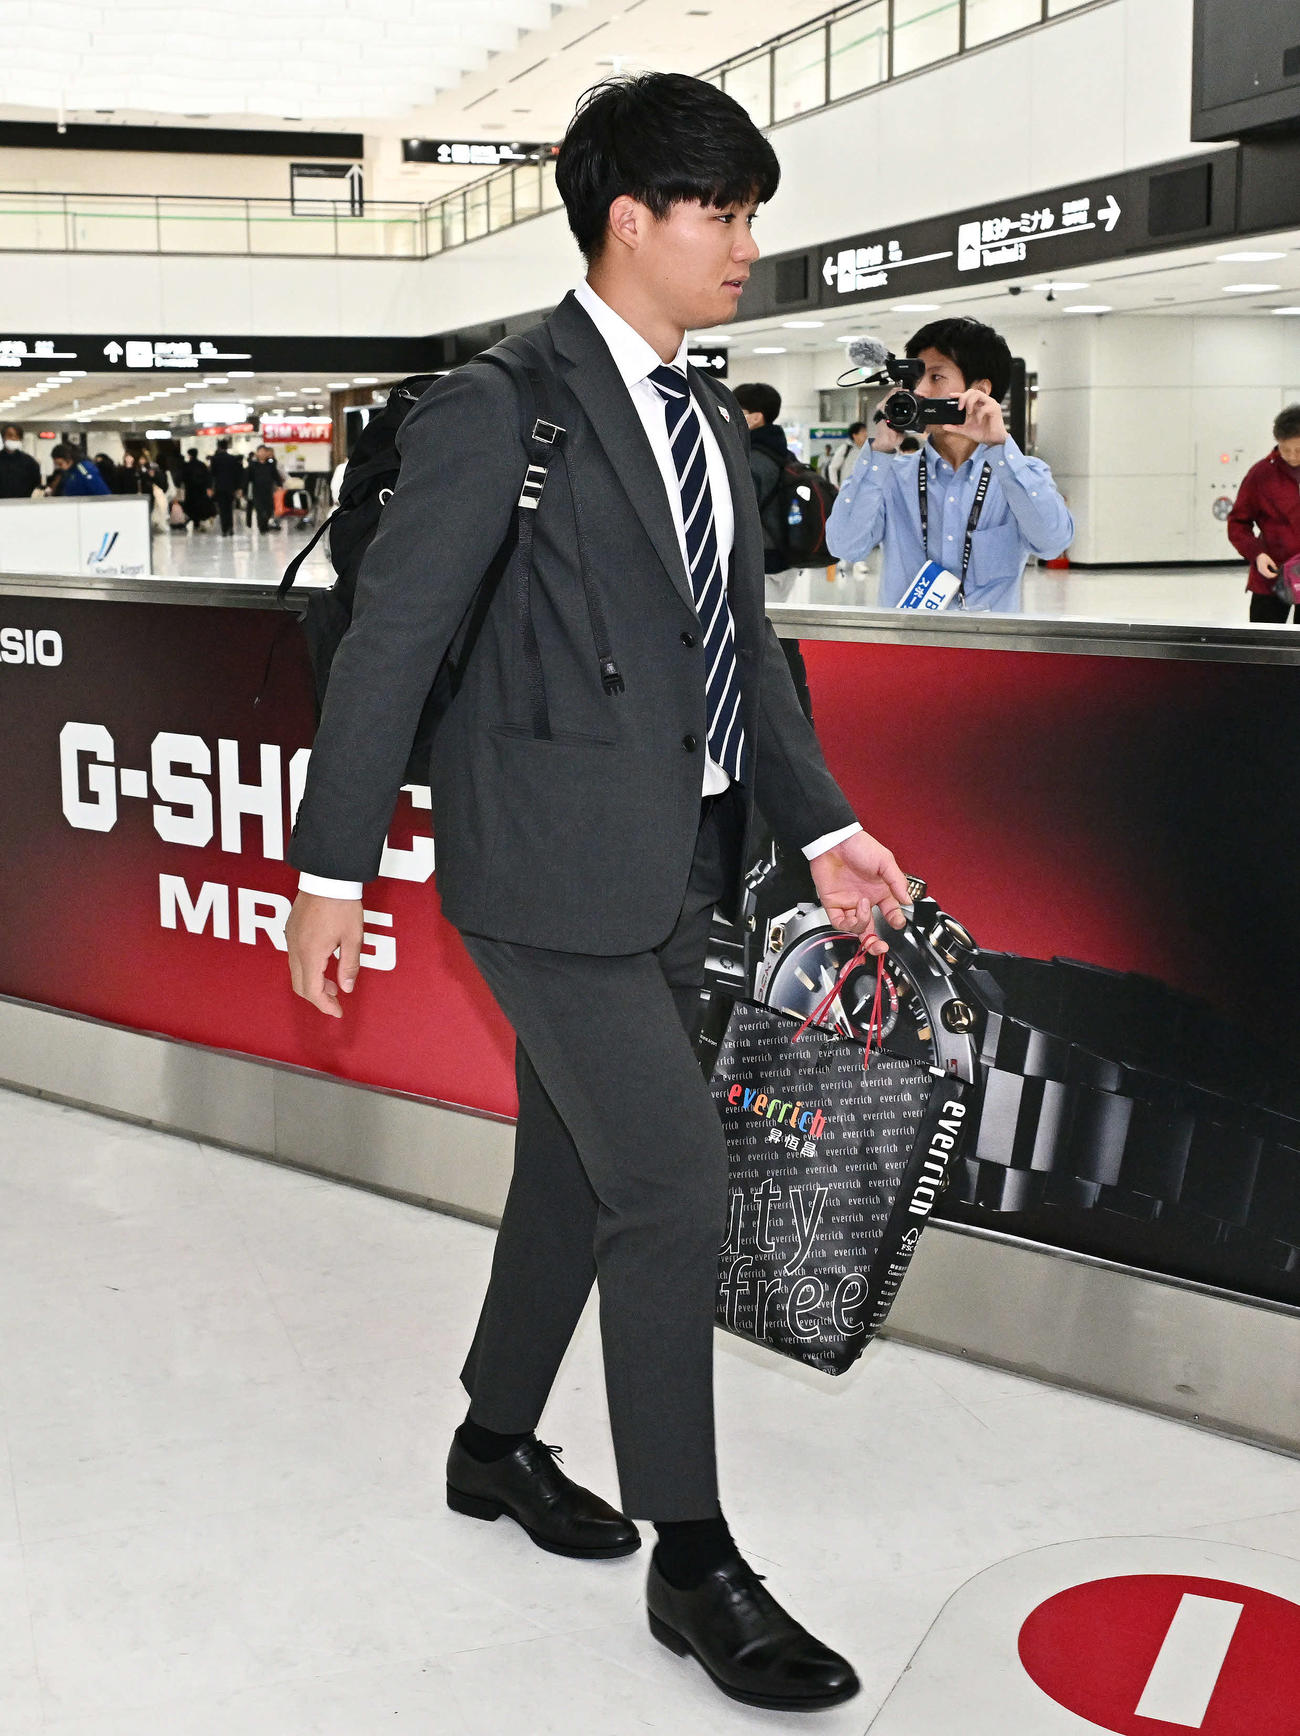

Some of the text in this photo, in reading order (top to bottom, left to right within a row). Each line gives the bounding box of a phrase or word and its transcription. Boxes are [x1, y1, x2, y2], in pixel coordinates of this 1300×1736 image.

[976, 476, 989, 501] MEDIA
[0, 627, 63, 667] SIO
[59, 721, 436, 884] G-SHC
[159, 873, 397, 972] MRG
[740, 1021, 770, 1032] everrich
[724, 1038, 750, 1049] verrich
[758, 1036, 788, 1046] everrich
[718, 1056, 734, 1066] rrich
[742, 1053, 772, 1064] everrich
[780, 1050, 810, 1060] everrich
[818, 1047, 850, 1058] everrich
[723, 1070, 752, 1081] everrich
[760, 1068, 791, 1078] everrich
[798, 1065, 830, 1076] everrich
[711, 1089, 729, 1098] verri
[782, 1083, 814, 1093] everrich
[820, 1080, 853, 1091] everrich
[860, 1077, 892, 1088] everrich
[900, 1074, 932, 1085] everrich
[840, 1095, 872, 1106] everrich
[880, 1092, 912, 1102] everrich
[722, 1120, 738, 1130] rrich
[746, 1118, 776, 1128] everrich
[862, 1110, 896, 1120] everrich
[902, 1108, 926, 1118] everr
[728, 1083, 825, 1138] everrich
[726, 1136, 756, 1146] everrich
[842, 1128, 874, 1139] everrich
[882, 1126, 914, 1136] everrich
[748, 1151, 779, 1162] everrich
[826, 1146, 858, 1156] everrich
[866, 1144, 898, 1154] everrich
[908, 1100, 966, 1216] everrich
[728, 1160, 908, 1180] everrich everrich everrich everrich everr
[828, 1180, 860, 1190] everrich
[868, 1178, 900, 1188] everrich
[769, 1201, 793, 1210] everri
[848, 1196, 880, 1206] everrich
[717, 1178, 829, 1276] uty
[832, 1213, 864, 1224] everrich
[771, 1234, 800, 1243] everric
[851, 1229, 884, 1239] everrich
[754, 1251, 786, 1261] everrich
[834, 1247, 867, 1257] everrich
[740, 1268, 766, 1278] verrich
[774, 1266, 806, 1277] eveich
[814, 1264, 846, 1275] everrich
[721, 1255, 869, 1341] free
[820, 1334, 847, 1343] everric
[802, 1350, 835, 1360] everrich
